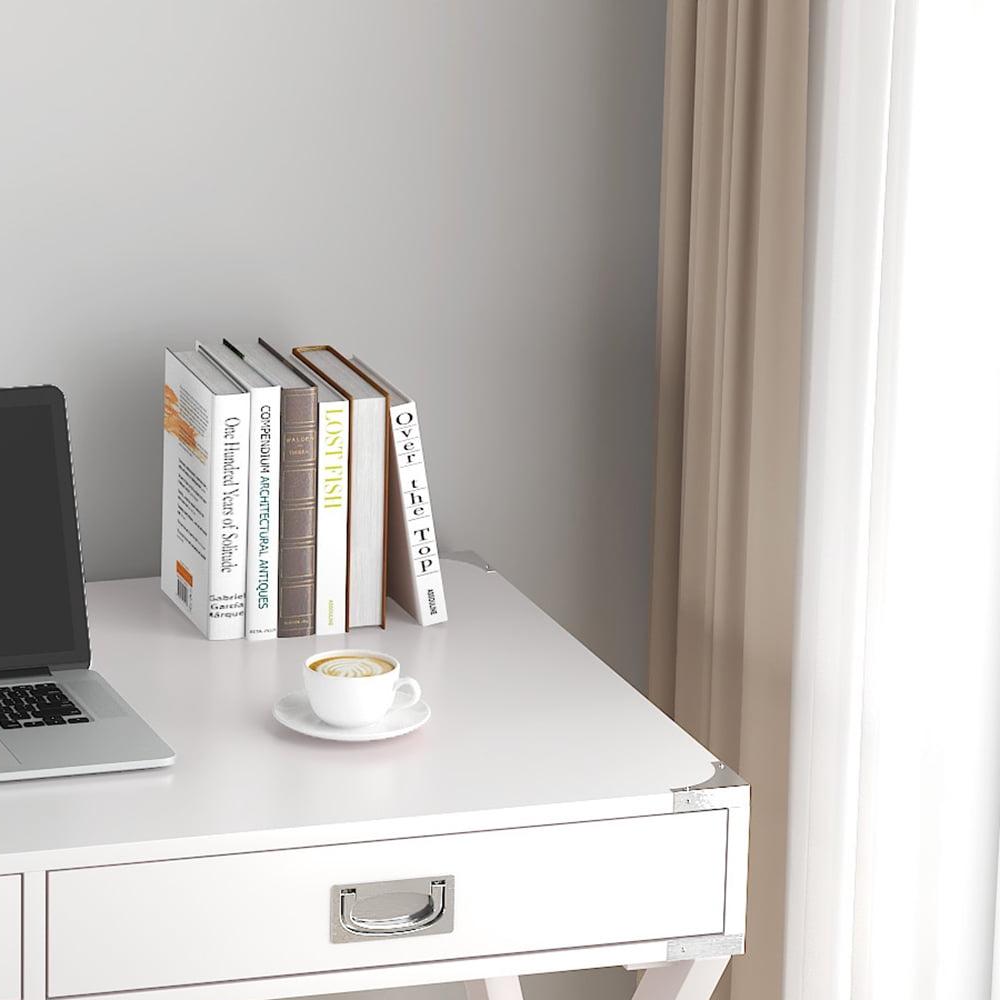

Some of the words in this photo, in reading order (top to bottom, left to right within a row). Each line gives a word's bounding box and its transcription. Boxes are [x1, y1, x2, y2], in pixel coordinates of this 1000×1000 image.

[224, 417, 240, 439] One
[260, 405, 271, 473] COMPENDIUM
[325, 409, 344, 459] LOST
[223, 442, 241, 486] Hundred
[396, 412, 416, 463] Over
[410, 479, 424, 516] the
[222, 488, 239, 515] Years
[324, 465, 343, 508] FISH
[222, 518, 239, 530] of
[259, 476, 270, 557] ARCHITECTURAL
[221, 533, 239, 573] Solitude
[256, 560, 269, 609] ANTIQUES
